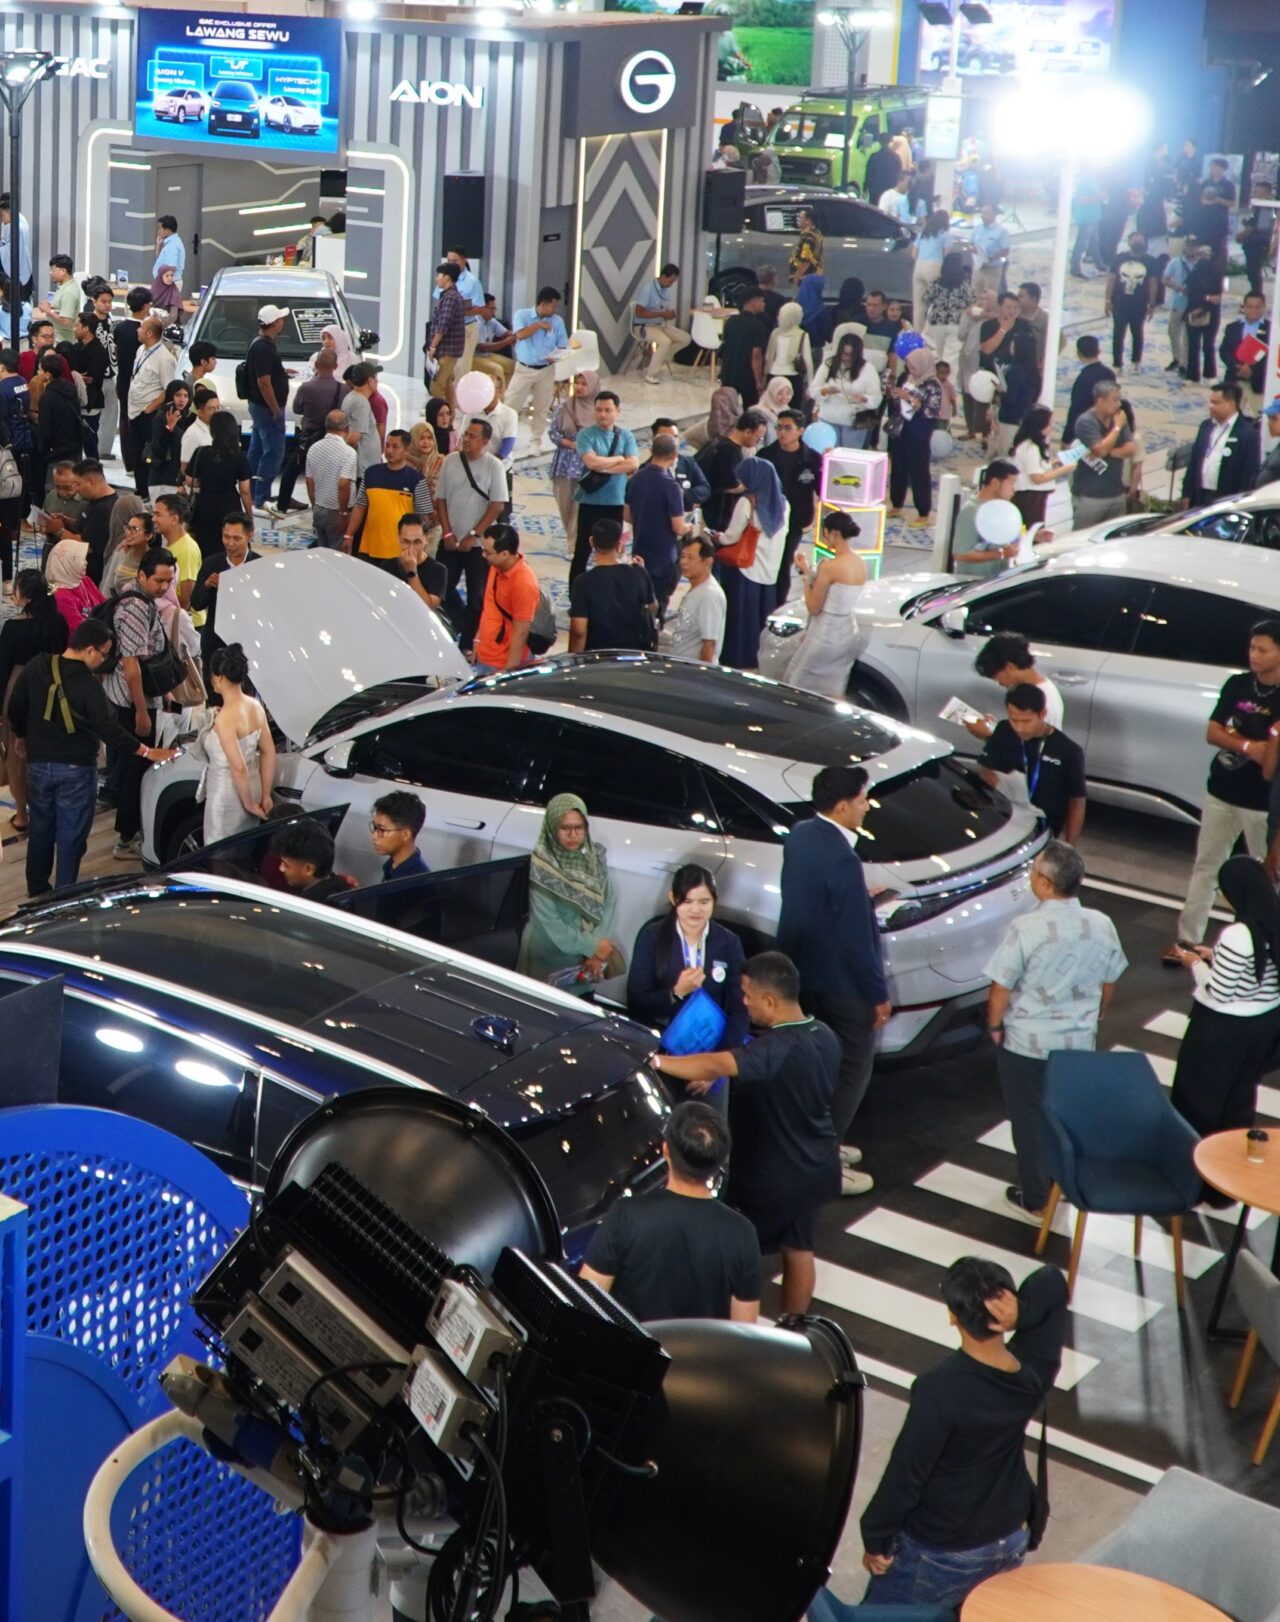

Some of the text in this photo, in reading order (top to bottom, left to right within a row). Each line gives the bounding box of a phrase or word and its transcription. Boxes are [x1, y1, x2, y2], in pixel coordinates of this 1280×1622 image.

[185, 25, 290, 42] LAWANG SEWU
[389, 79, 483, 109] AION
